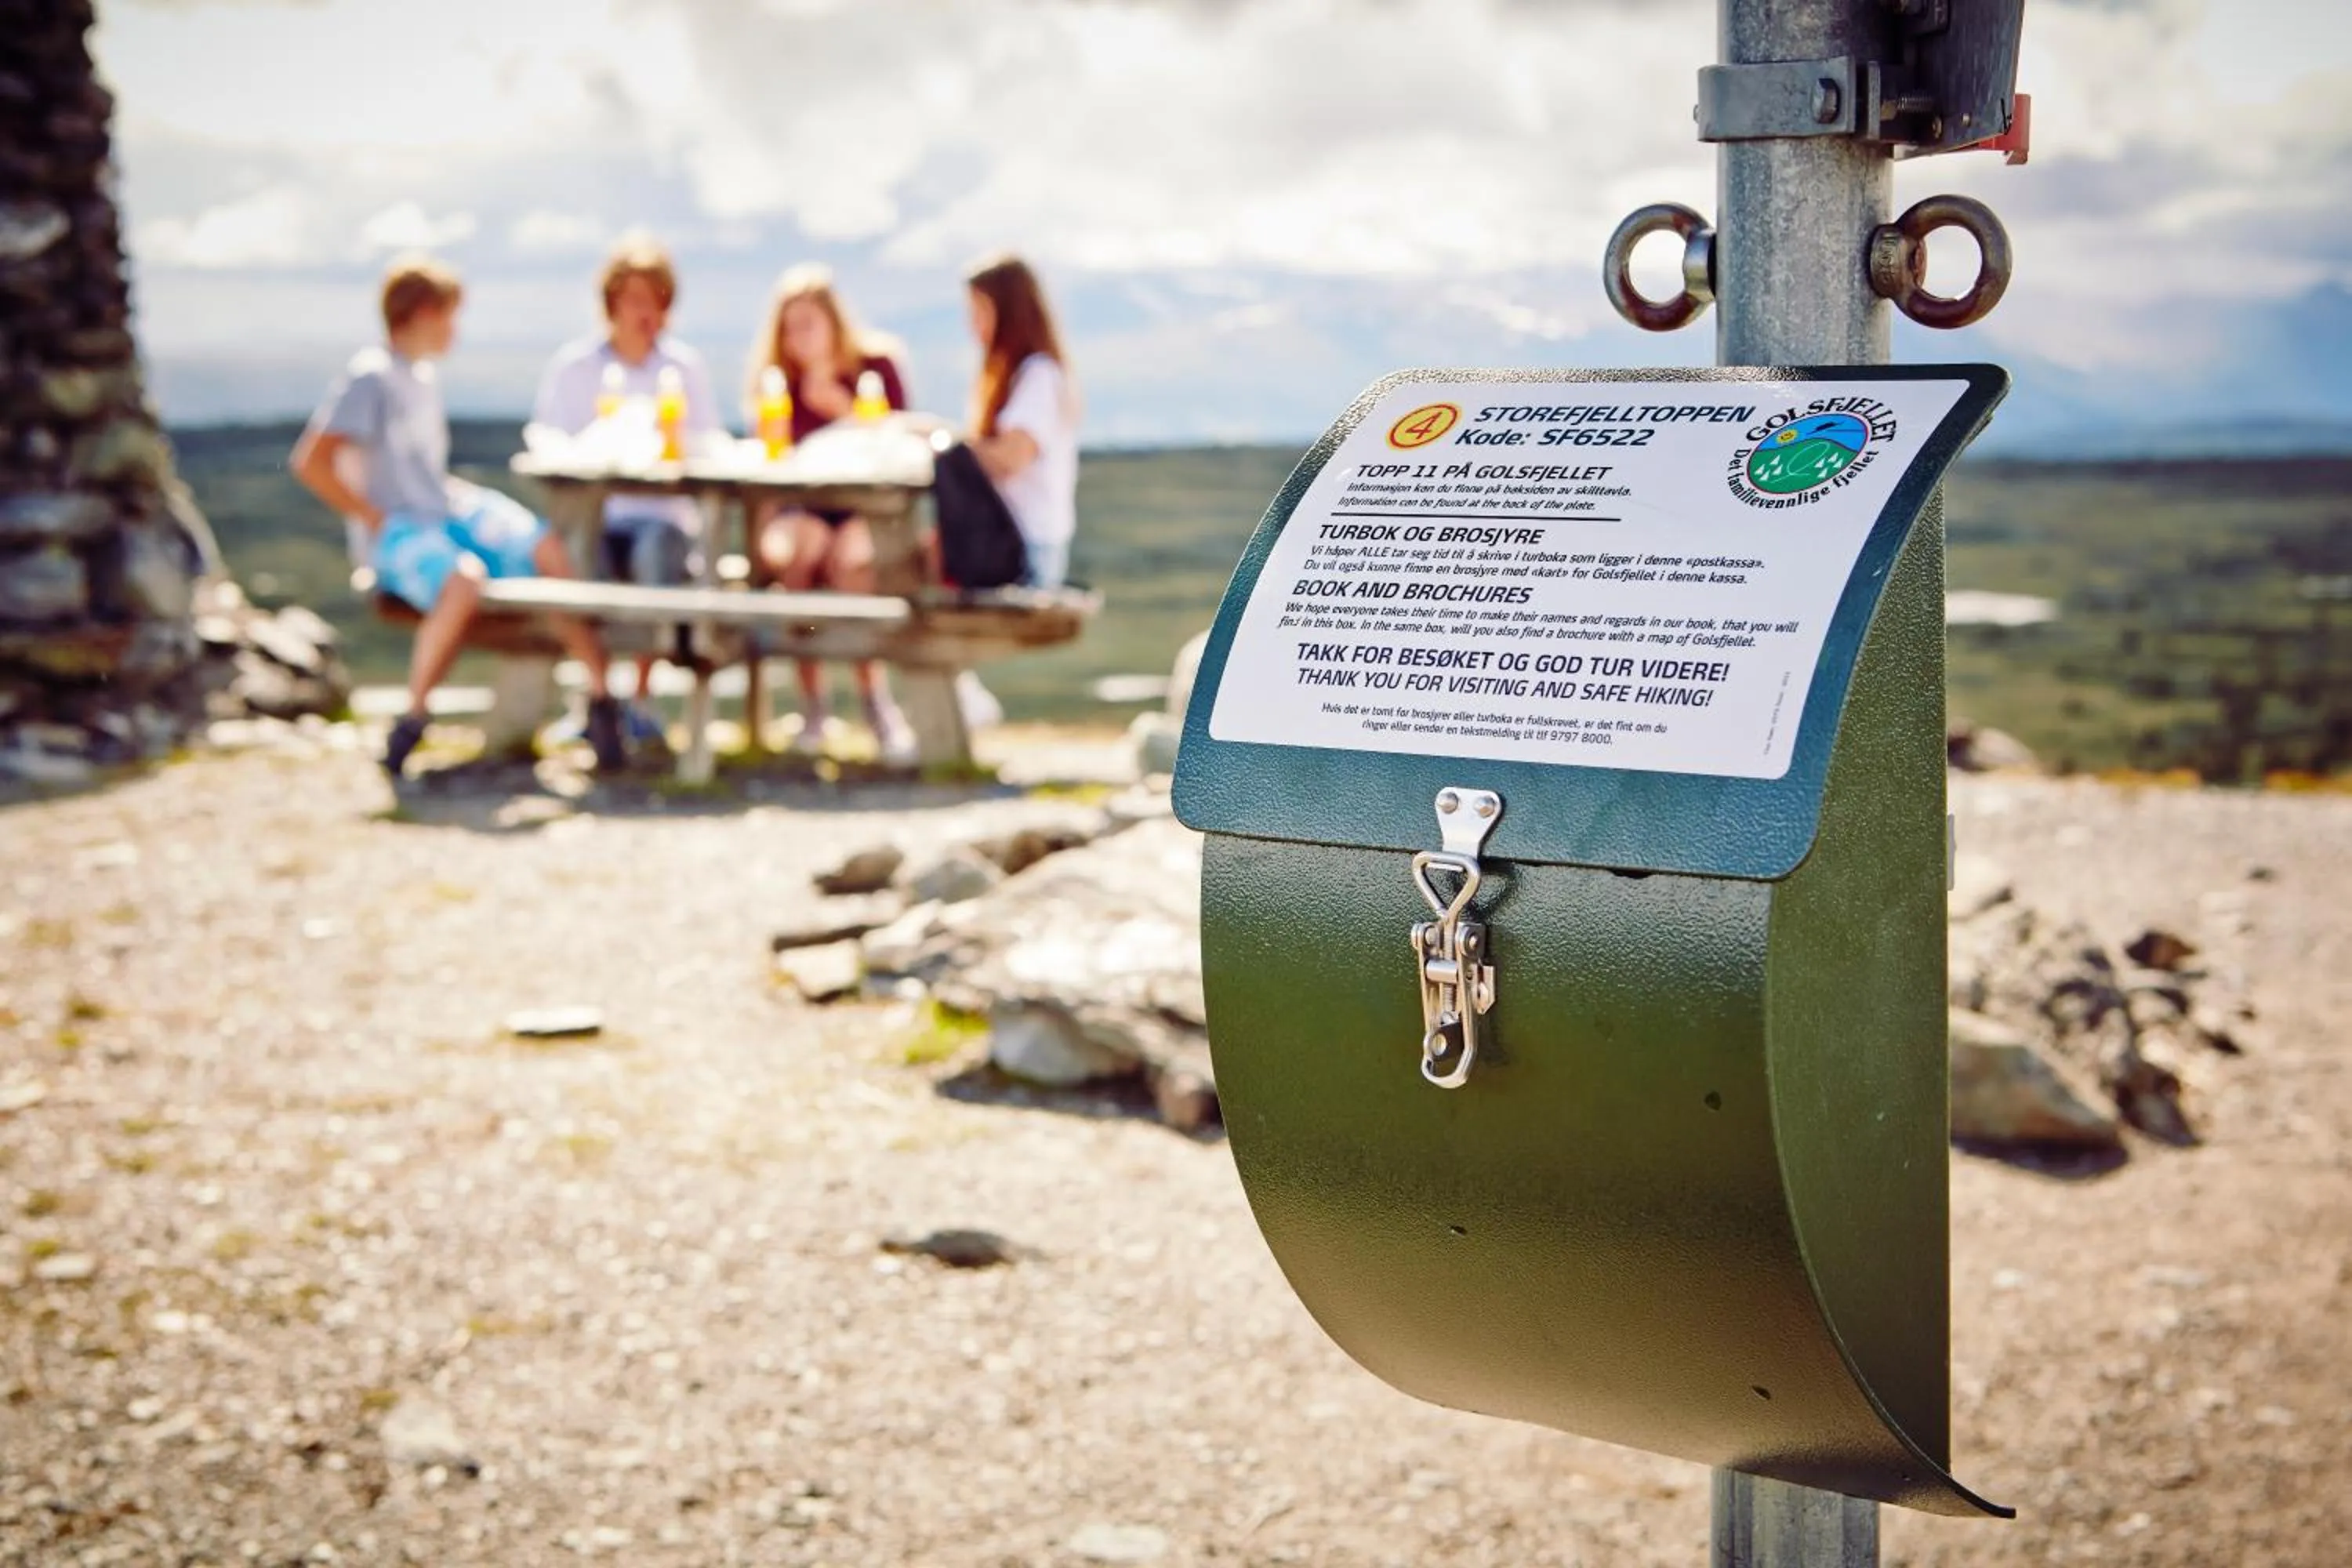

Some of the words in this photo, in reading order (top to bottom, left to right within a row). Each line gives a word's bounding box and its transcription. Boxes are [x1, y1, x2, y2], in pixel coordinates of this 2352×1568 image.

[1405, 412, 1443, 439] 4
[1474, 406, 1756, 424] STOREFJELLTOPPEN
[1746, 397, 1896, 441] GOLSFJELLET
[1455, 430, 1530, 445] Kode:
[1537, 430, 1656, 445] SF6522
[1727, 448, 1751, 470] Det
[1832, 451, 1879, 488] fjellet
[1357, 465, 1410, 477] TOPP
[1412, 466, 1438, 477] 11
[1443, 462, 1473, 477] PÅ
[1475, 465, 1613, 481] GOLSFJELLET
[1347, 483, 1411, 494] Informasjon
[1414, 484, 1435, 493] kan
[1437, 485, 1451, 493] du
[1454, 485, 1483, 494] finne
[1485, 484, 1502, 495] på
[1503, 485, 1554, 495] baksiden
[1557, 486, 1571, 495] av
[1727, 472, 1831, 509] familievennlige
[1338, 497, 1397, 507] Information
[1420, 498, 1433, 507] be
[1435, 498, 1466, 508] found
[1468, 499, 1480, 507] at
[1482, 499, 1500, 508] the
[1501, 499, 1528, 509] back
[1530, 499, 1544, 510] of
[1545, 500, 1563, 509] the
[1319, 524, 1400, 541] TURBOK
[1403, 526, 1435, 541] OG
[1438, 527, 1544, 546] BROSJYRE
[1311, 546, 1323, 556] Vi
[1324, 546, 1356, 557] håper
[1357, 546, 1390, 557] ALLE
[1392, 547, 1410, 558] tar
[1411, 550, 1430, 560] seg
[1432, 548, 1450, 559] tid
[1452, 548, 1465, 559] til
[1477, 549, 1512, 561] skrive
[1522, 552, 1566, 562] turboka
[1569, 554, 1595, 564] som
[1598, 553, 1635, 567] ligger
[1644, 554, 1682, 566] denne
[1304, 559, 1320, 570] Du
[1323, 560, 1336, 571] vil
[1338, 561, 1364, 574] også
[1367, 561, 1401, 572] kunne
[1403, 561, 1433, 573] finne
[1436, 565, 1450, 574] en
[1453, 564, 1499, 577] brosjyre
[1501, 566, 1529, 576] med
[1571, 568, 1589, 579] for
[1592, 568, 1657, 582] Golsfjellet
[1668, 571, 1705, 583] denne
[1292, 579, 1352, 597] BOOK
[1353, 582, 1400, 598] AND
[1403, 583, 1534, 603] BROCHURES
[1285, 601, 1303, 612] We
[1305, 603, 1330, 615] hope
[1332, 605, 1379, 616] everyone
[1381, 605, 1410, 617] takes
[1411, 607, 1437, 618] their
[1438, 608, 1465, 619] time
[1465, 609, 1478, 619] to
[1479, 609, 1511, 621] make
[1512, 610, 1538, 622] their
[1541, 615, 1577, 624] names
[1580, 614, 1603, 625] and
[1604, 616, 1646, 628] regards
[1649, 616, 1661, 626] in
[1663, 619, 1683, 628] our
[1722, 619, 1746, 631] that
[1748, 622, 1772, 634] you
[1774, 622, 1798, 633] will
[1277, 616, 1301, 628] find
[1301, 618, 1313, 626] in
[1314, 617, 1333, 627] this
[1360, 619, 1372, 630] In
[1374, 620, 1391, 630] the
[1393, 622, 1423, 632] same
[1450, 623, 1472, 633] will
[1473, 626, 1493, 637] you
[1495, 625, 1519, 636] also
[1519, 626, 1544, 638] find
[1556, 630, 1606, 640] brochure
[1608, 630, 1635, 642] with
[1646, 634, 1673, 645] map
[1675, 633, 1691, 645] of
[1297, 643, 1348, 662] TAKK
[1352, 646, 1393, 665] FOR
[1398, 648, 1495, 670] BESØKET
[1498, 652, 1530, 672] OG
[1535, 655, 1583, 673] GOD
[1590, 657, 1634, 677] TUR
[1641, 659, 1730, 681] VIDERE!
[1297, 667, 1360, 688] THANK
[1363, 671, 1403, 689] YOU
[1405, 673, 1443, 692] FOR
[1448, 676, 1529, 697] VISITING
[1530, 681, 1576, 699] AND
[1581, 683, 1632, 703] SAFE
[1635, 686, 1715, 706] HIKING!
